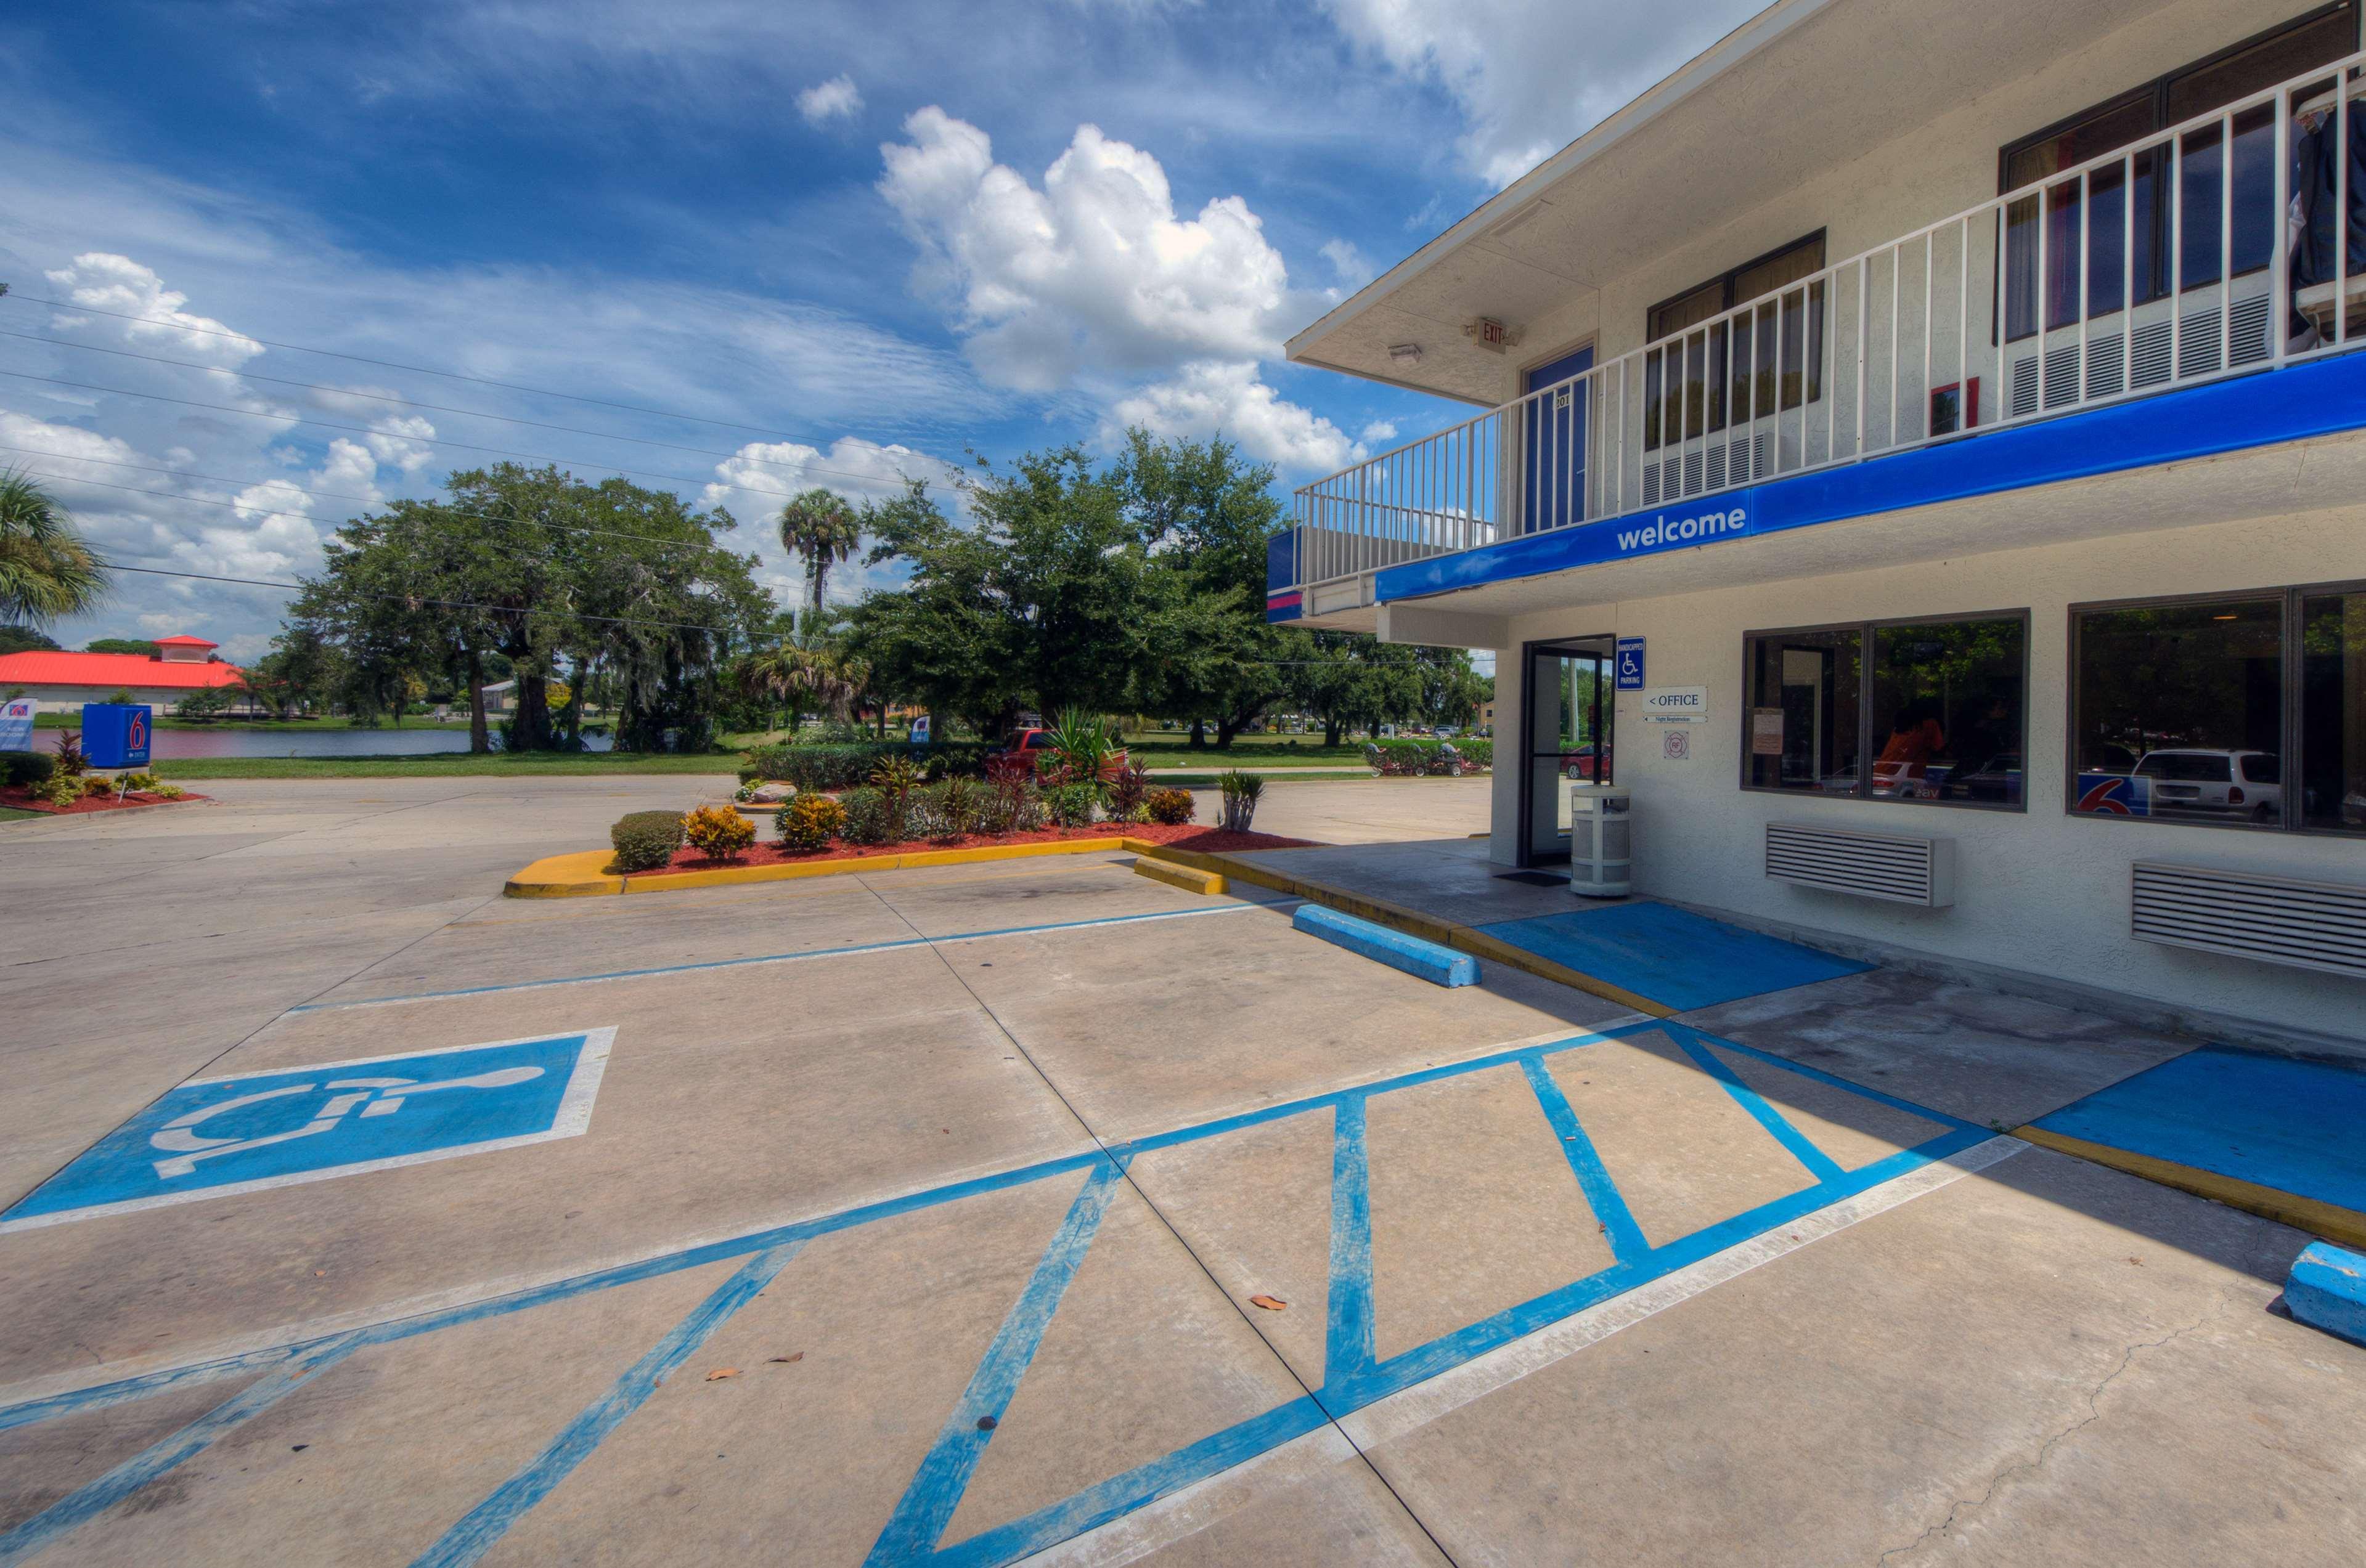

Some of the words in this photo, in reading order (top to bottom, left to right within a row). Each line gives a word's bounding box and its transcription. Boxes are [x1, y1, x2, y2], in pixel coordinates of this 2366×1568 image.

[1484, 322, 1503, 345] EXIT
[1617, 508, 1746, 550] welcome
[1618, 643, 1643, 651] HANDICAPPED
[1620, 676, 1640, 684] PARKING
[1658, 694, 1699, 706] OFFICE
[129, 711, 145, 749] 6
